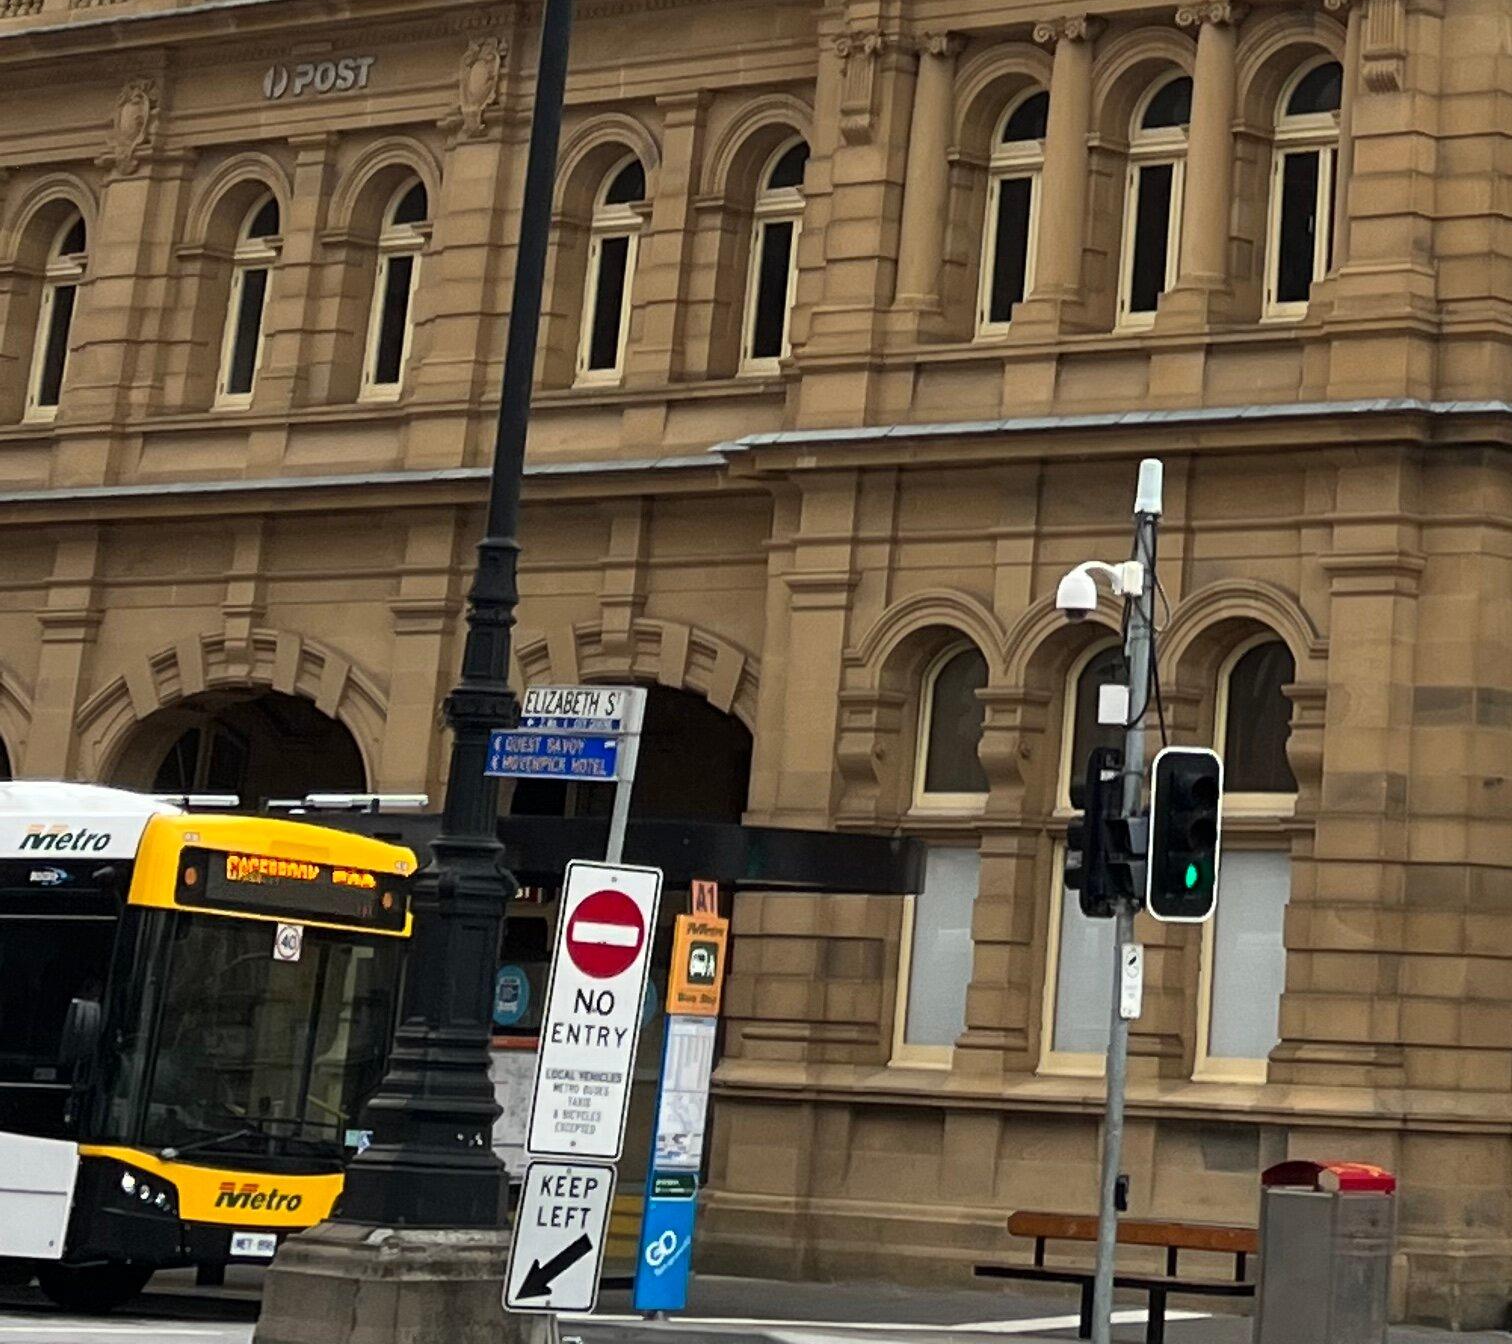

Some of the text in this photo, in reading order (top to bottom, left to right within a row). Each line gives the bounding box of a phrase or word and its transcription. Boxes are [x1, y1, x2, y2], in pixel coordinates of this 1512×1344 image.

[293, 56, 375, 97] POST
[525, 689, 600, 716] ELIZABETH
[19, 824, 111, 851] Metro
[696, 882, 715, 912] A1
[573, 987, 615, 1016] NO
[551, 1021, 629, 1049] ENTRY
[545, 1067, 623, 1084] LOCAL VEHICLES
[214, 1182, 303, 1212] Metro
[540, 1175, 599, 1200] KEEP
[536, 1205, 592, 1230] LEFT
